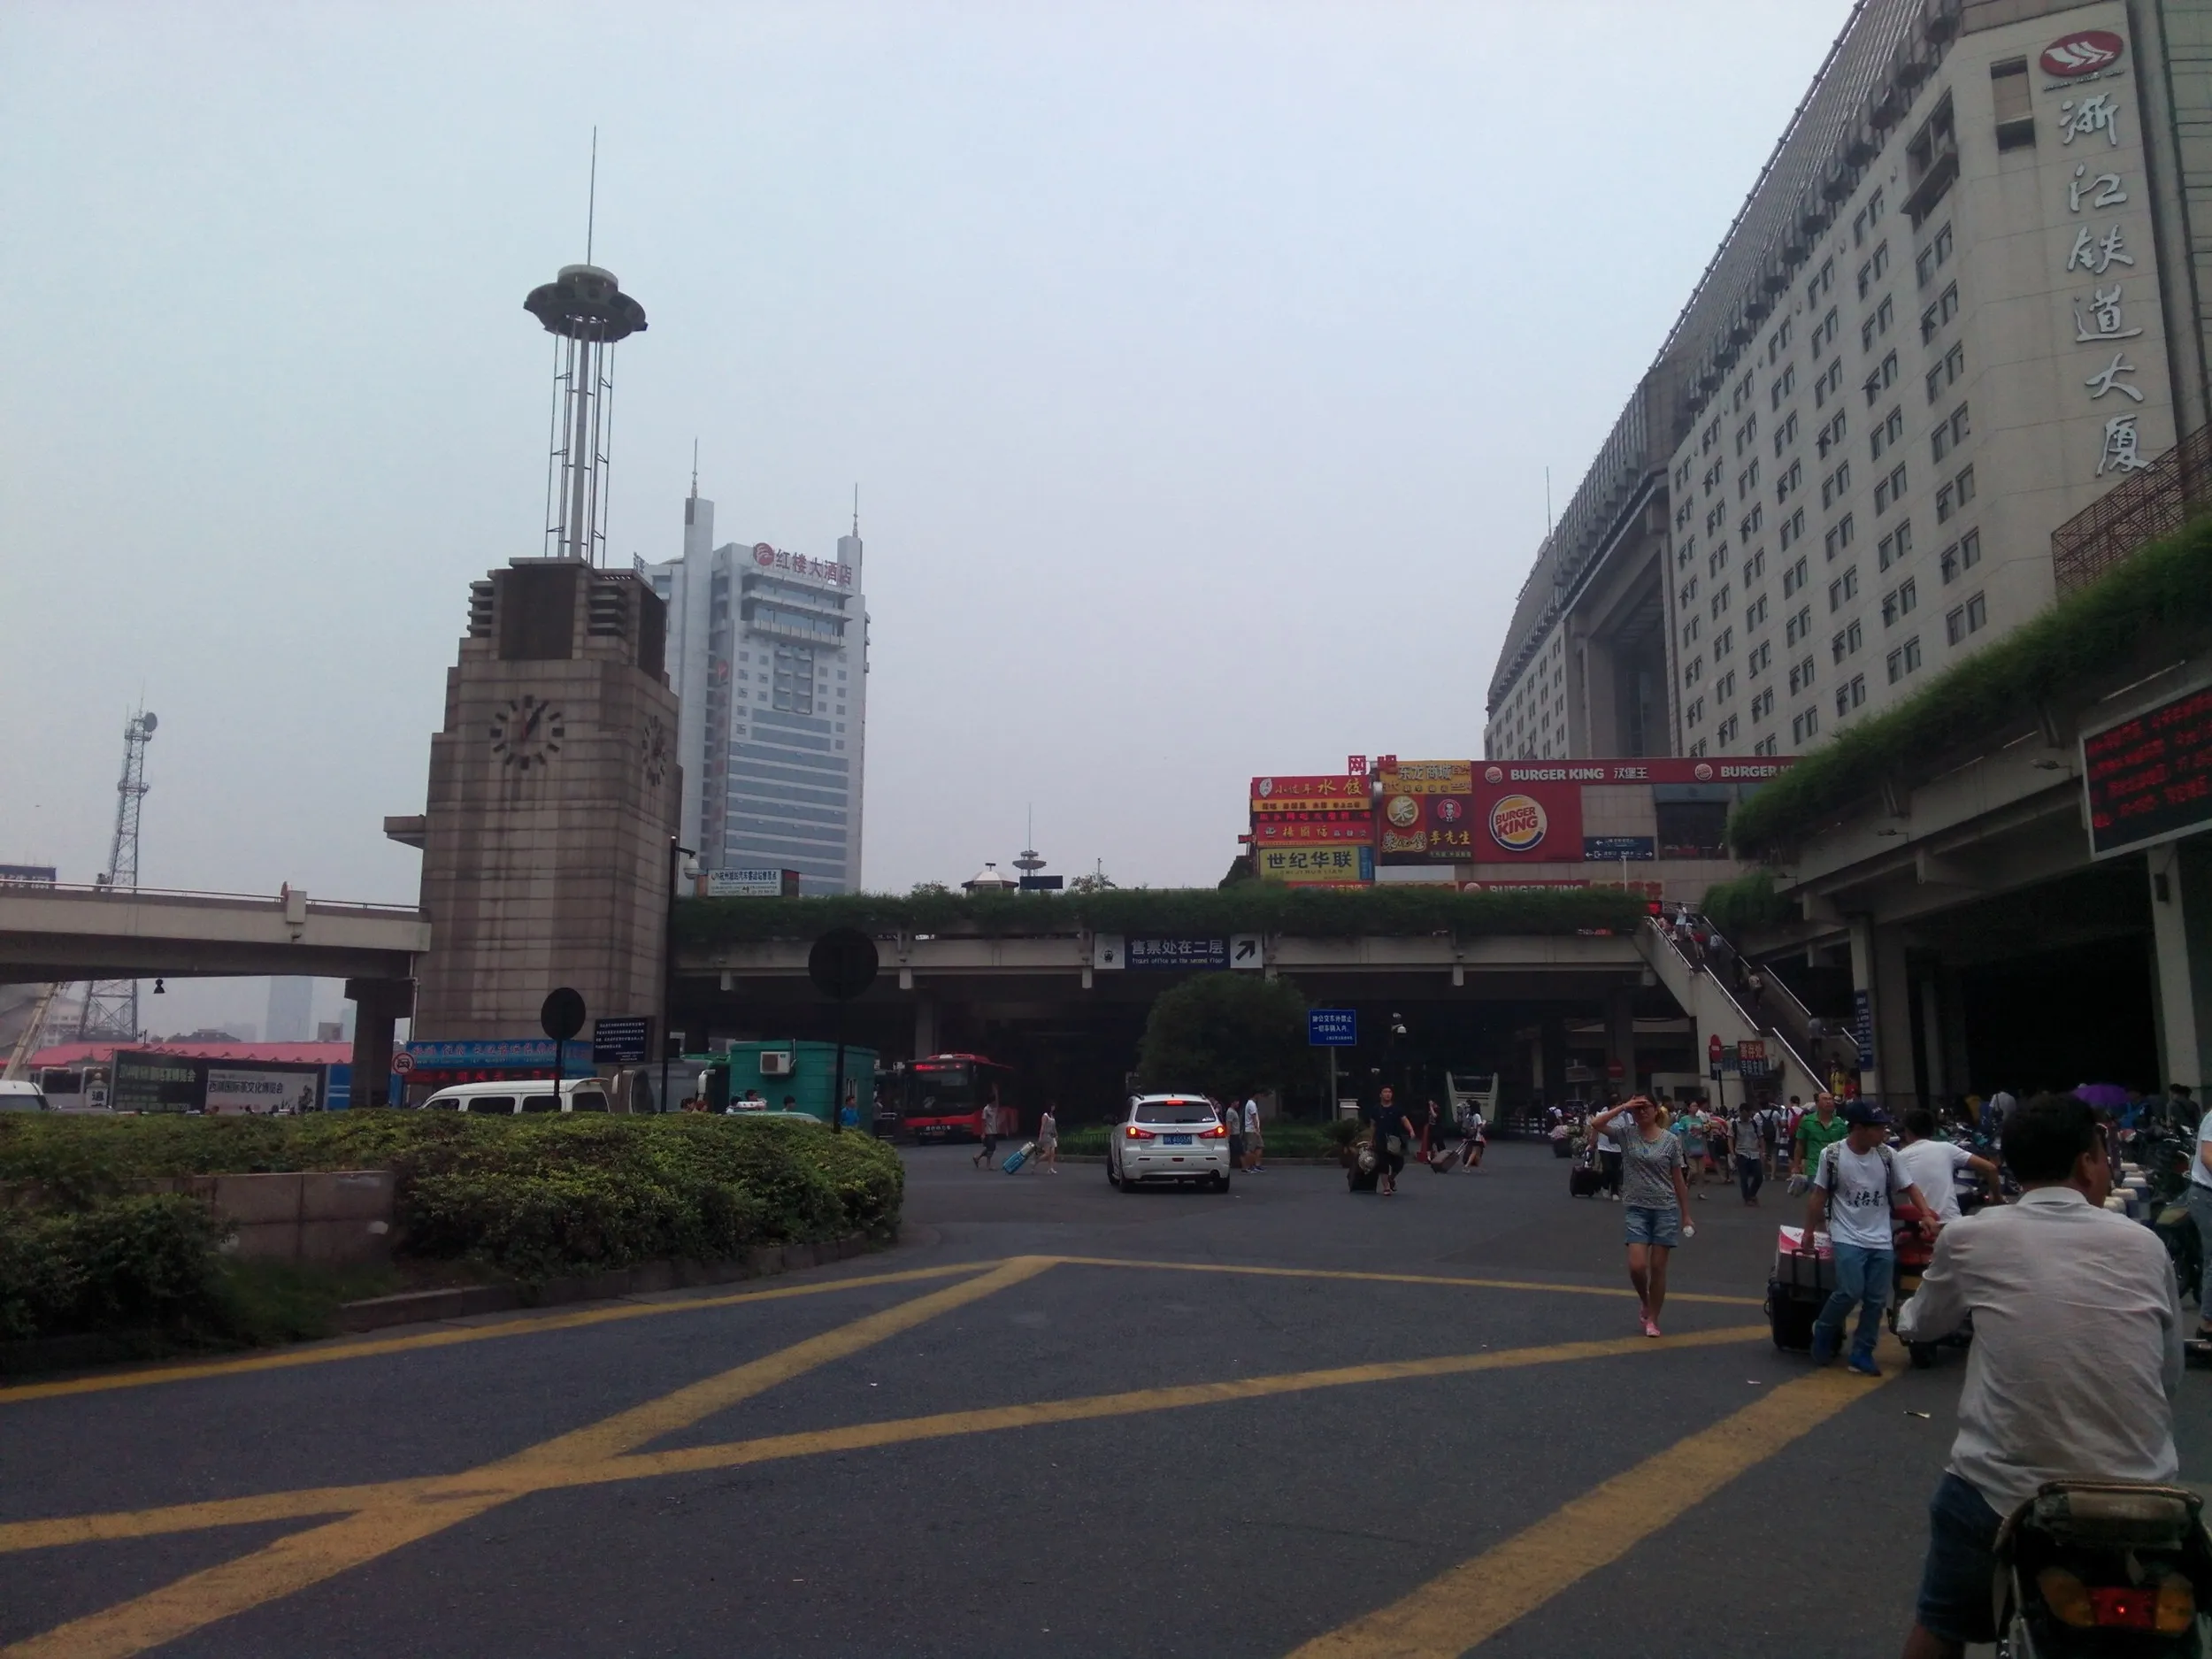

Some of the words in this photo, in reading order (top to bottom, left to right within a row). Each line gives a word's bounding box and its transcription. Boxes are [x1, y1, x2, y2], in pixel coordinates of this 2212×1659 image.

[2059, 91, 2150, 478] 浙江铁道大厦
[776, 549, 852, 586] 红楼大酒店
[1510, 769, 1565, 780] BURGER
[1569, 768, 1604, 780] KING
[1614, 767, 1648, 780] 汉堡王
[1720, 765, 1777, 777] BURGER
[1496, 807, 1536, 825] BURGER
[1498, 815, 1539, 838] KING
[1430, 830, 1471, 845] 李先生
[1266, 850, 1352, 869] 世纪华联
[1132, 940, 1225, 955] 售票处在二层
